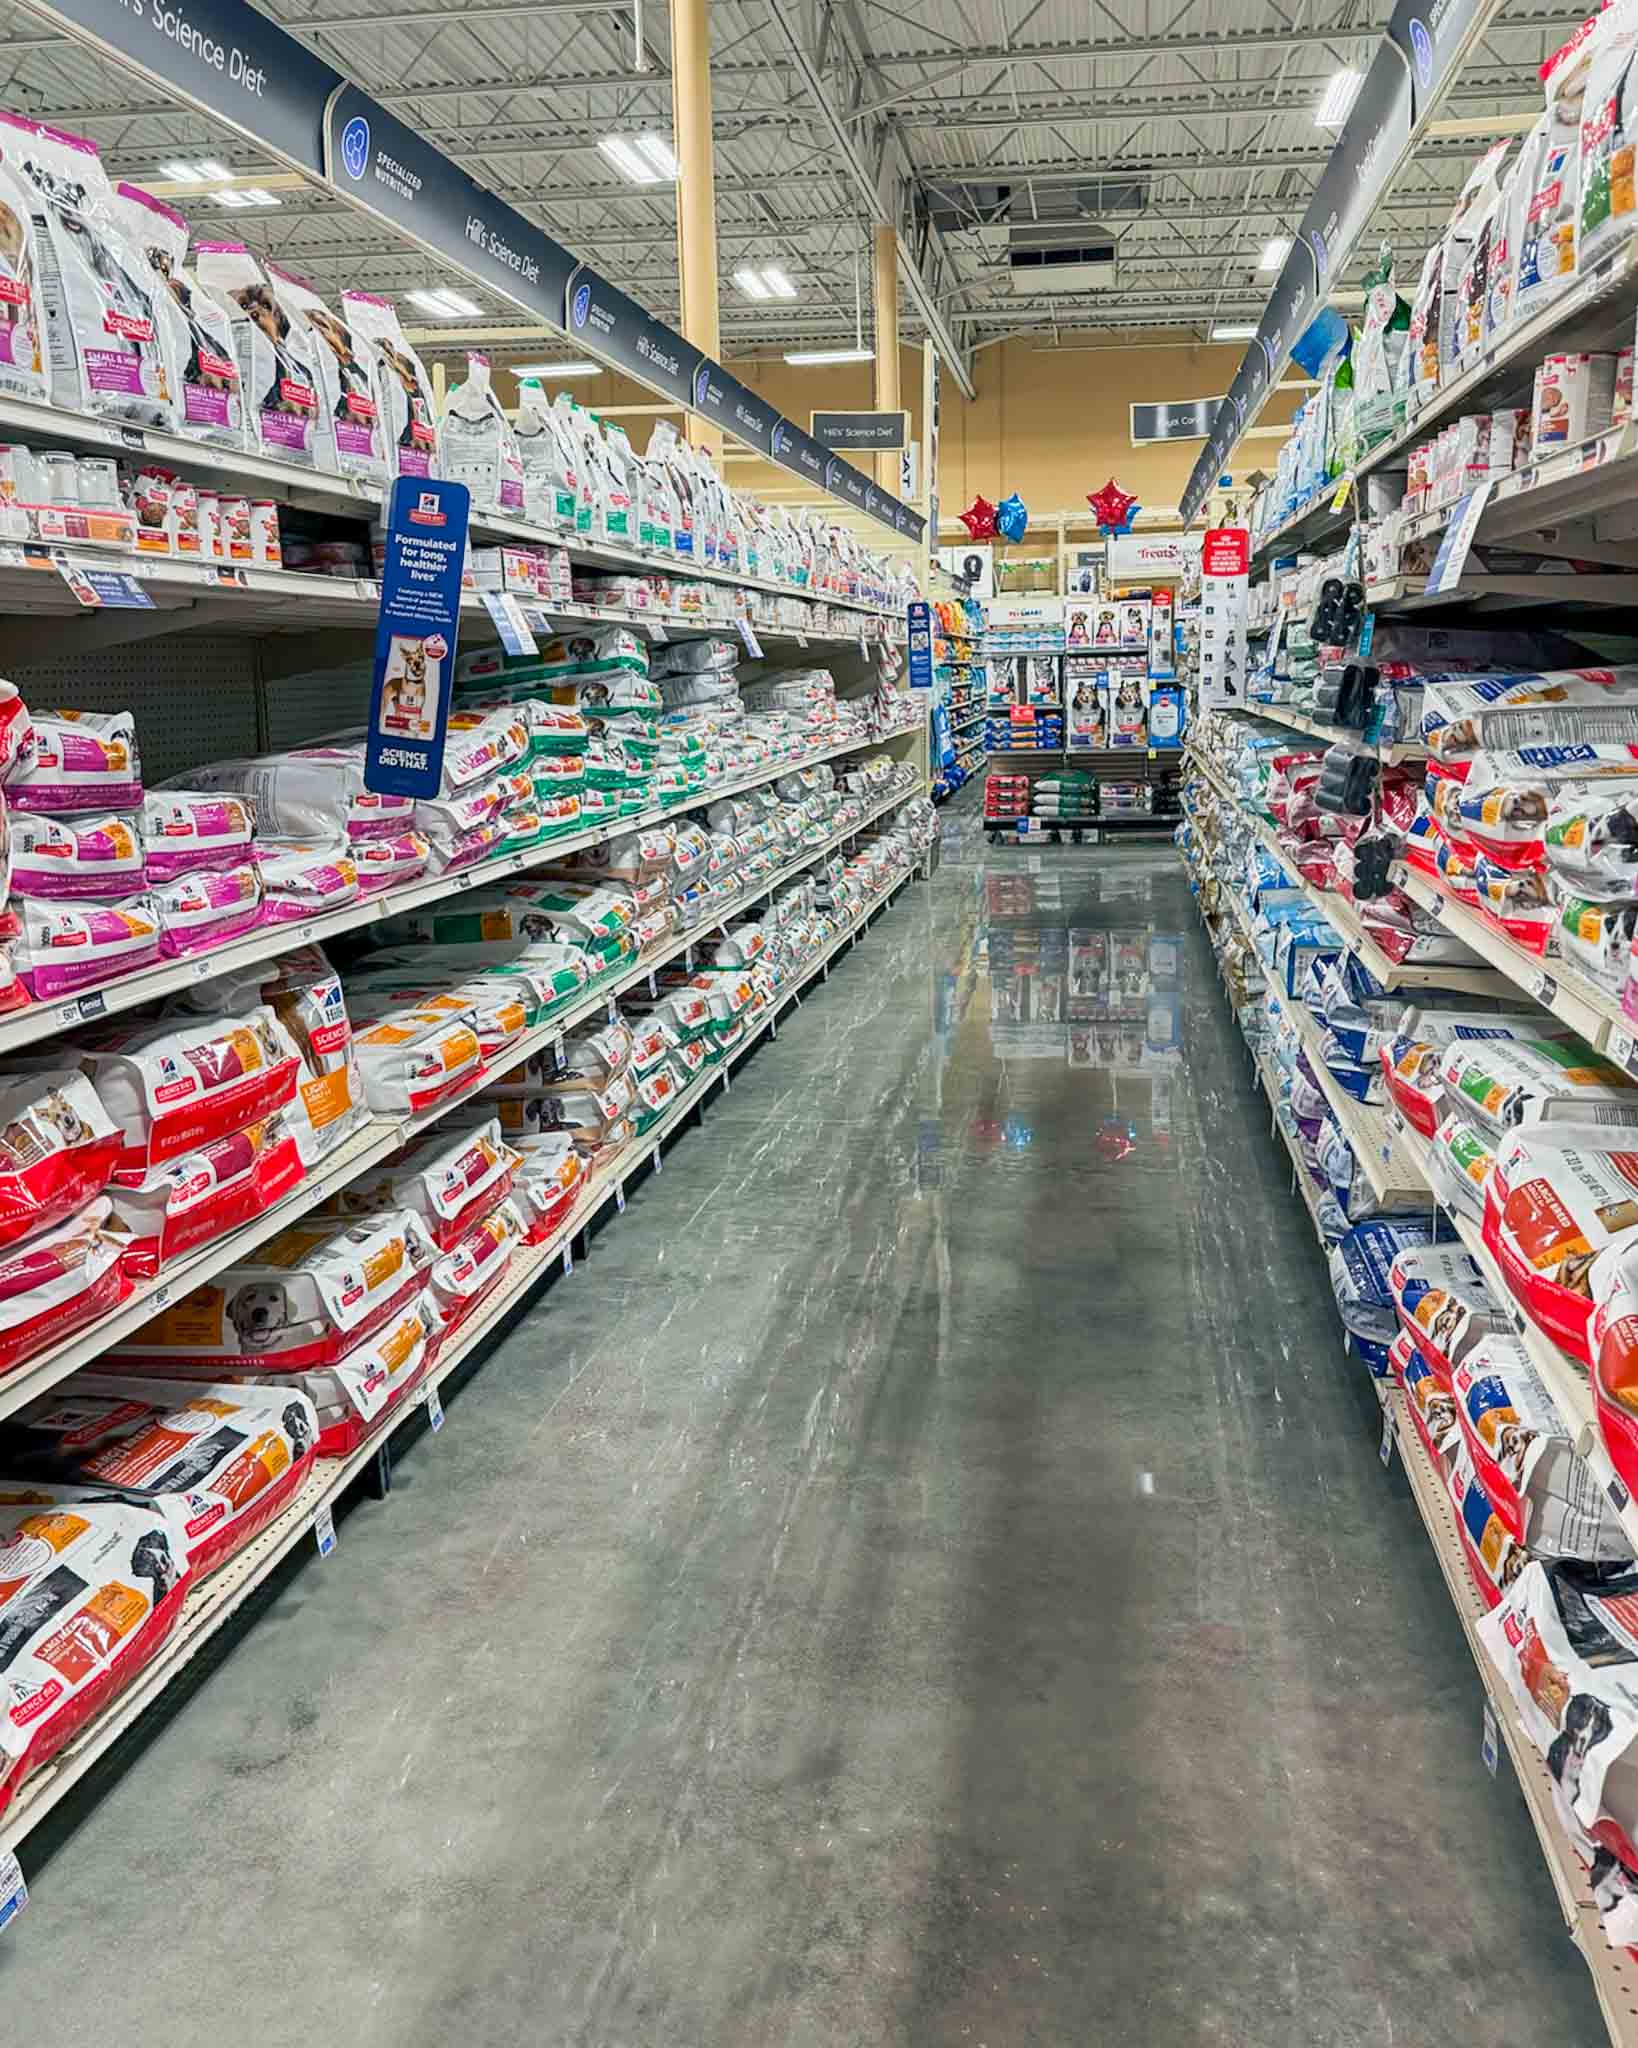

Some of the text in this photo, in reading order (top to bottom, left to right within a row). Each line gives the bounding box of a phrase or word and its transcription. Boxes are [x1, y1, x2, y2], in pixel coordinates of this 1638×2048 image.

[152, 0, 263, 97] Science Diet
[394, 533, 457, 552] Formulated
[402, 545, 418, 557] for
[400, 556, 448, 573] healthier
[378, 754, 428, 771] DID THAT.
[382, 747, 429, 761] SCIENCE
